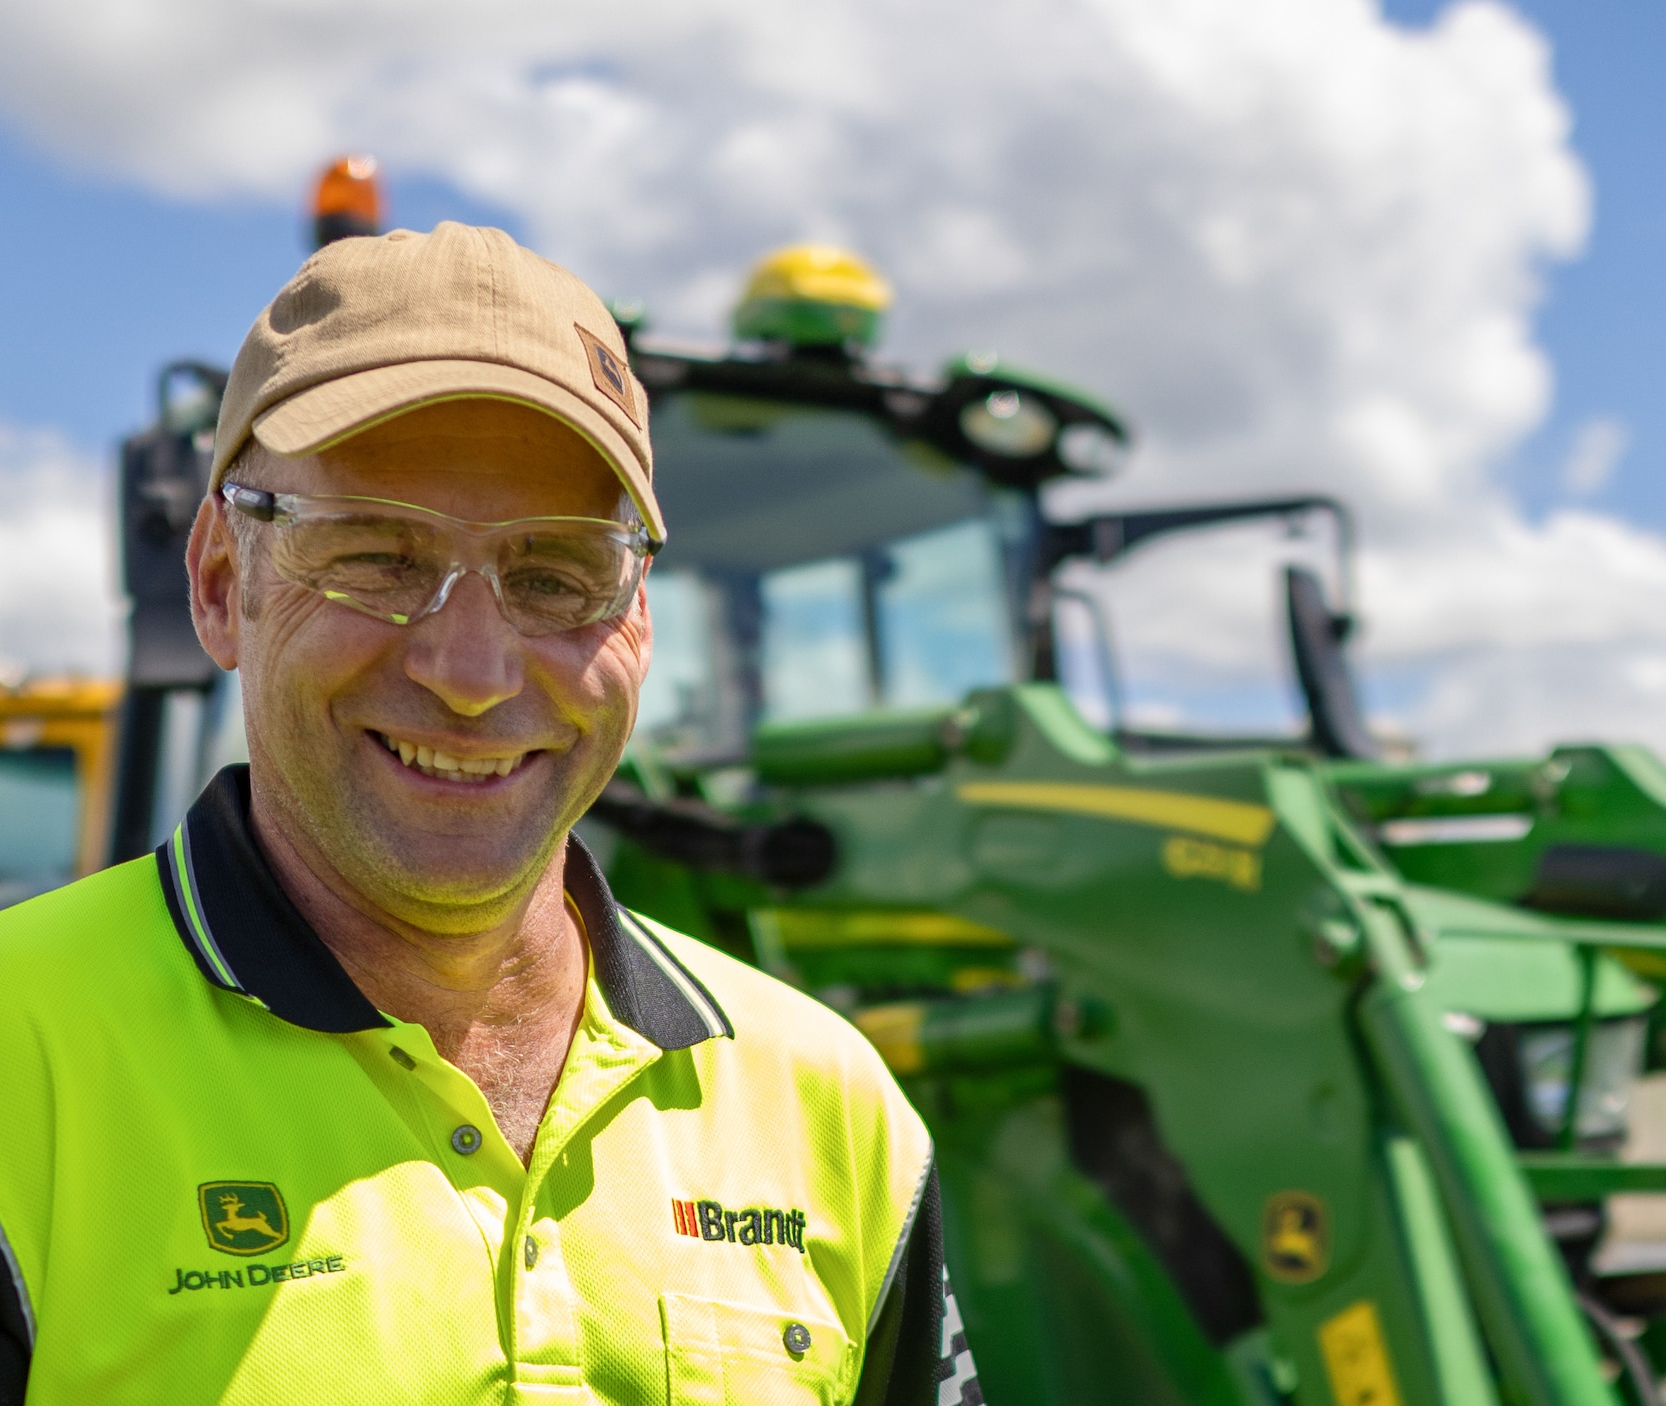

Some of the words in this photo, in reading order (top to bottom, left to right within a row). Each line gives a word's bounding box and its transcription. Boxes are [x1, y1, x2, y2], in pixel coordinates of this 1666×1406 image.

[697, 1199, 806, 1254] Brandt
[168, 1268, 244, 1295] JOHN
[247, 1255, 345, 1286] DEERE
